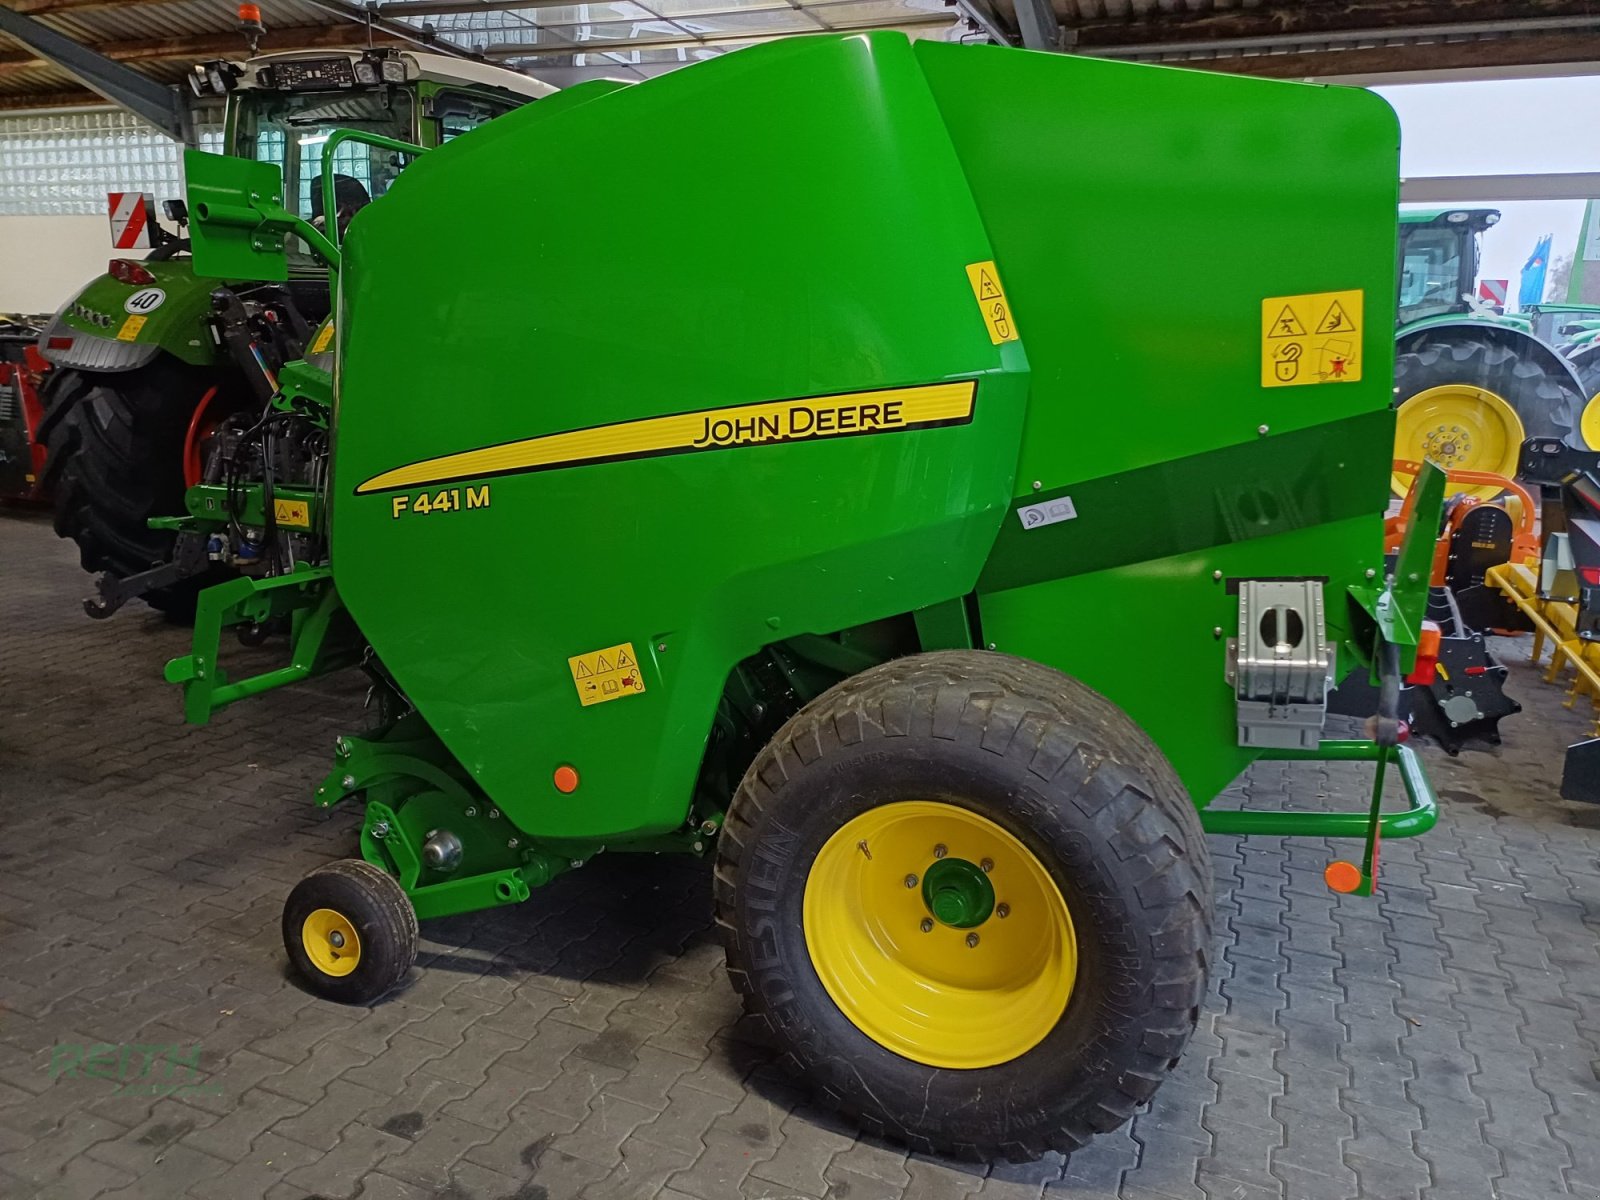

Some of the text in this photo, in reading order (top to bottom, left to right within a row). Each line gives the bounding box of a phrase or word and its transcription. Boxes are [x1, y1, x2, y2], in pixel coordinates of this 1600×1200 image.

[130, 291, 159, 309] 40
[693, 401, 903, 445] JOHN DEERE
[392, 485, 490, 518] F 441 M
